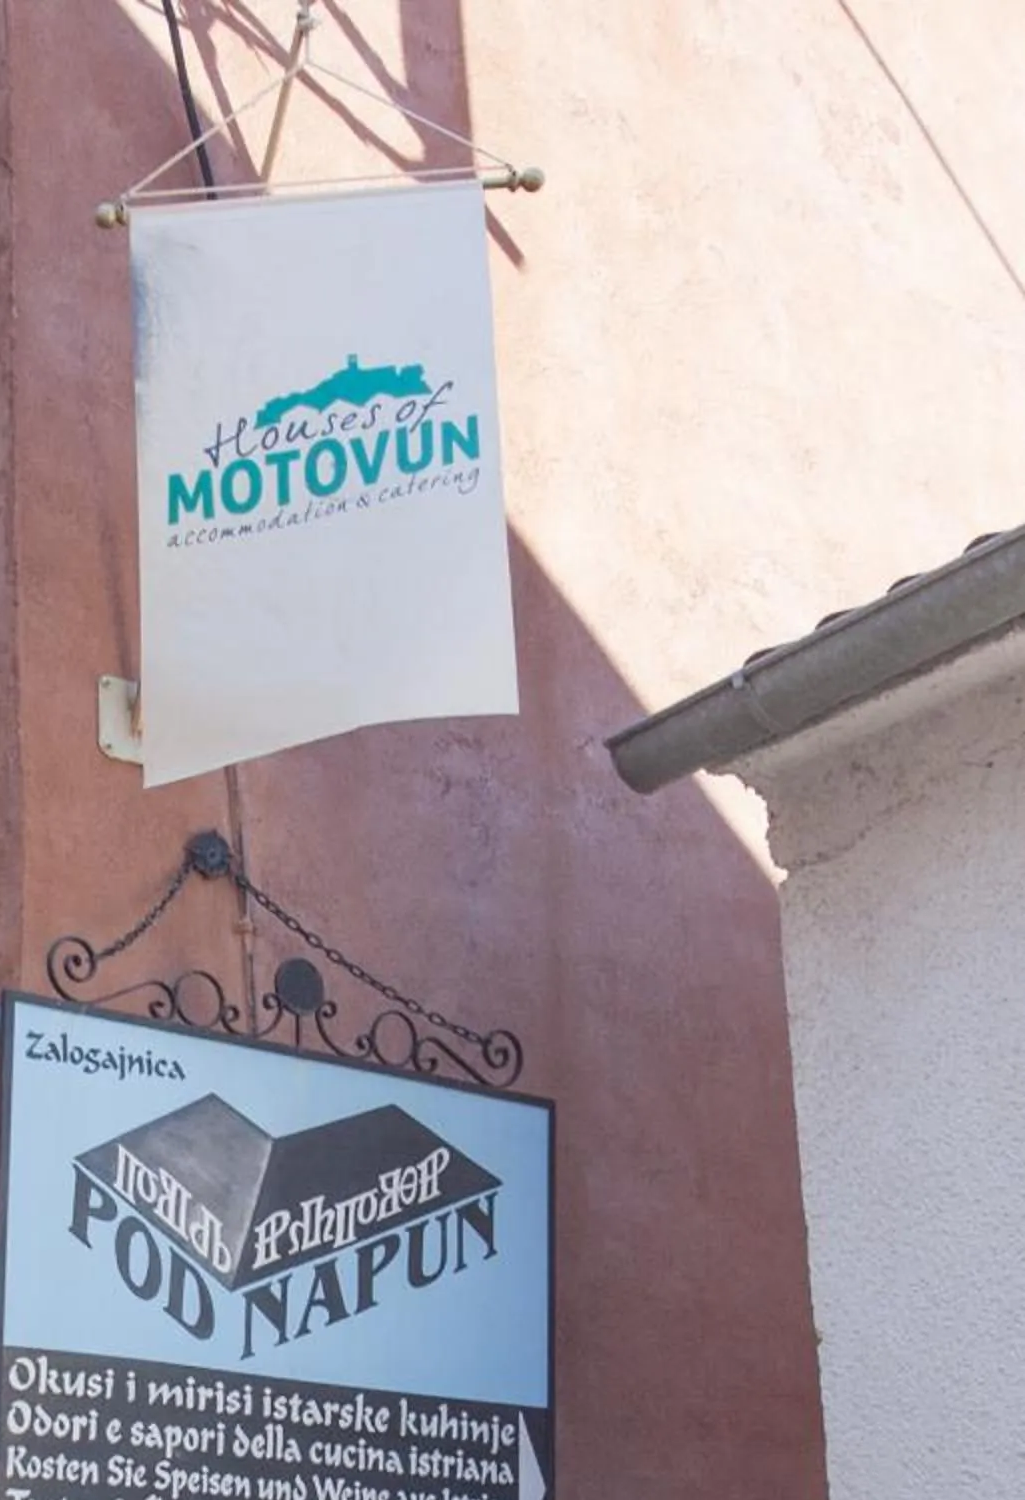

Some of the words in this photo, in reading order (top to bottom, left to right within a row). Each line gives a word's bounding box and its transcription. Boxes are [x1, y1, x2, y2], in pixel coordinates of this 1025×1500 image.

[204, 404, 382, 467] Houses
[395, 381, 454, 433] of
[167, 414, 480, 526] MOTOVUN
[167, 499, 349, 549] accommodation
[355, 492, 371, 509] &
[378, 467, 480, 503] catering
[25, 1031, 186, 1082] Zalogajnica
[69, 1160, 215, 1341] POD
[240, 1191, 498, 1361] NAPUN
[6, 1401, 98, 1442] Odori
[106, 1418, 123, 1444] e
[130, 1420, 225, 1459] sapori
[232, 1423, 302, 1463] della
[309, 1438, 404, 1474] cucina
[409, 1446, 514, 1485] istriana
[9, 1355, 115, 1399] Okusi
[126, 1371, 136, 1403] i
[148, 1376, 253, 1416] mirisi
[262, 1387, 391, 1433] istarske
[399, 1397, 516, 1454] kuhinje
[6, 1445, 99, 1486] Kosten
[107, 1455, 147, 1488] Sie
[153, 1460, 251, 1500] Speisen
